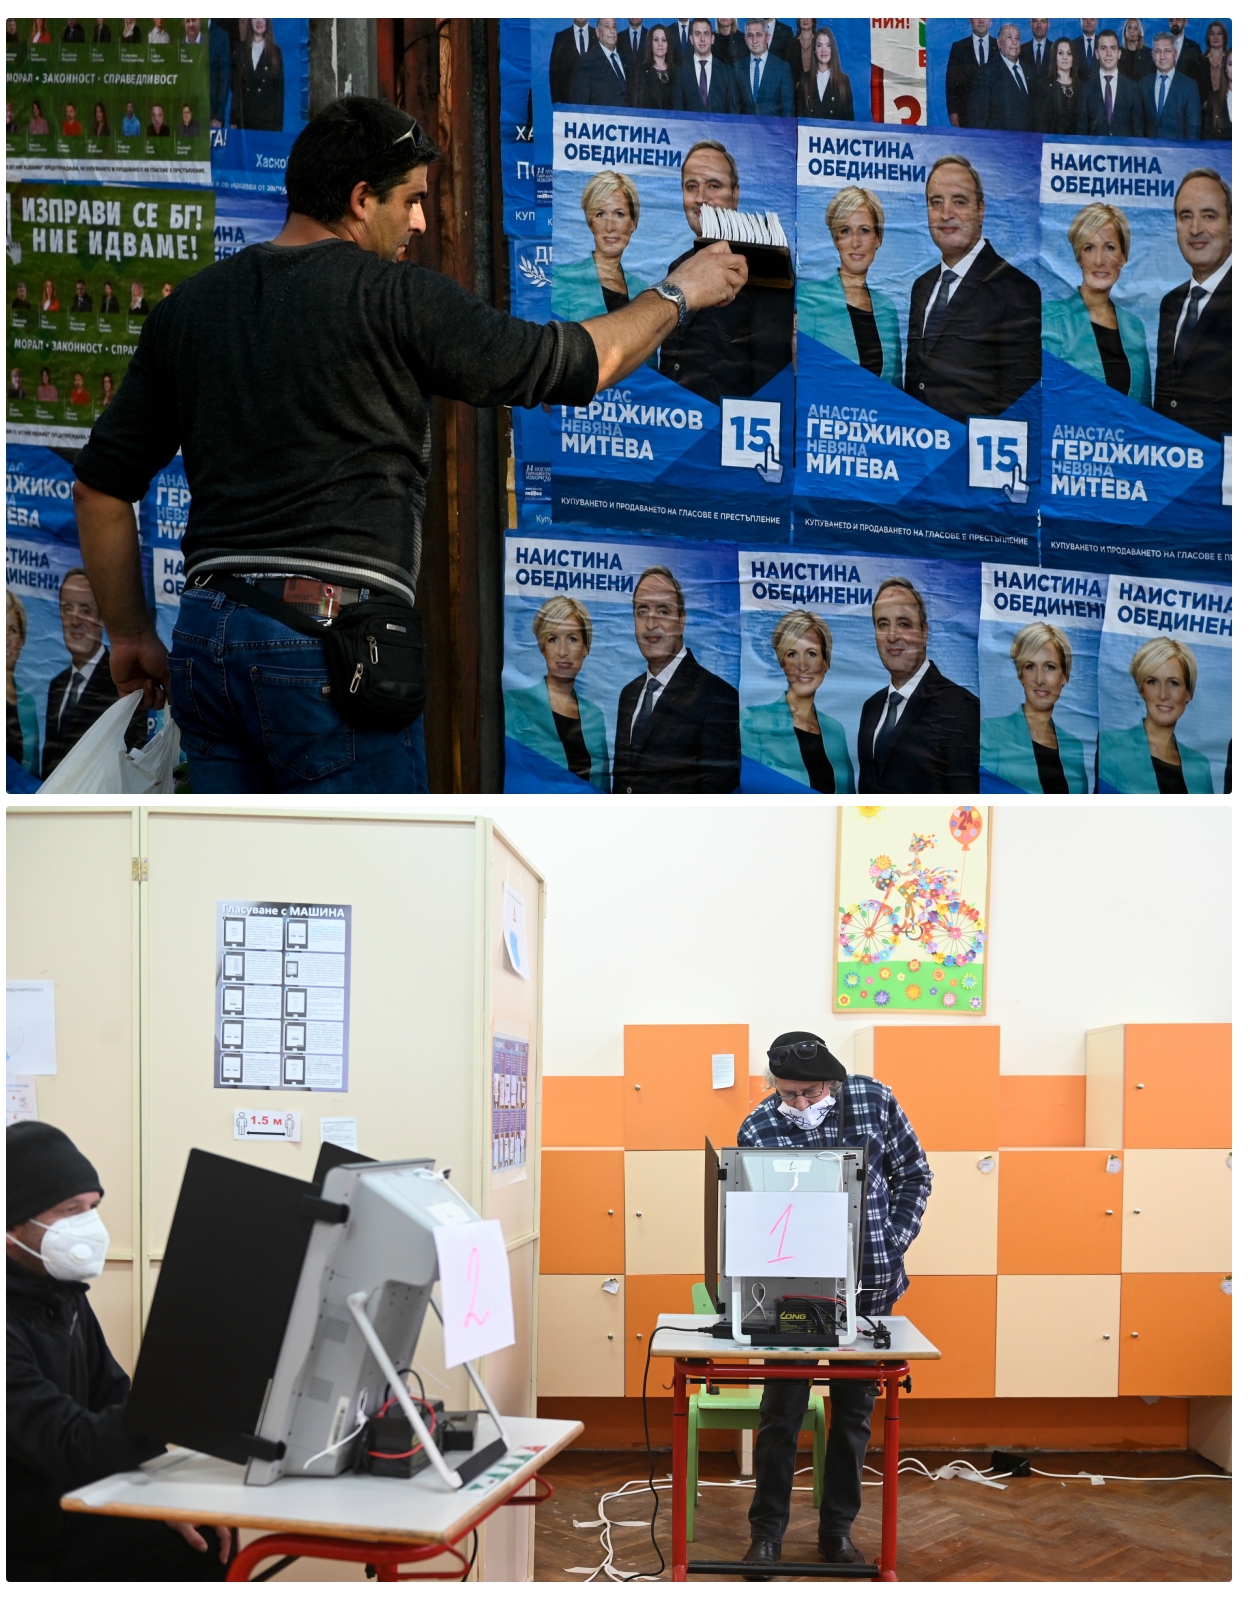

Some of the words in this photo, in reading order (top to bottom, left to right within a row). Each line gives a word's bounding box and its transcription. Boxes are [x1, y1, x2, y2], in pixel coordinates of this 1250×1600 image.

[6, 73, 33, 83] МОРАЛ
[42, 73, 95, 84] ЗАКОННОСТ
[103, 73, 178, 85] СПРАВЕДЛИВОСТ
[564, 121, 671, 146] НАИСТИНА
[564, 142, 682, 168] ОБЕДИНЕНИ
[808, 135, 914, 160] НАИСТИНА
[517, 161, 535, 180] П
[808, 158, 926, 183] ОБЕДИНЕНИ
[1051, 152, 1162, 175] НАИСТИНА
[1050, 175, 1175, 198] ОБЕДИНЕНИ
[22, 197, 120, 226] ИЗПРАВИ
[133, 202, 158, 228] СЕ
[170, 204, 202, 231] БГ!
[516, 211, 536, 221] КУП
[32, 227, 78, 254] НИЕ
[89, 230, 198, 261] ИДВАМЕ!
[14, 338, 43, 350] МОРАЛ
[52, 340, 103, 354] ЗАКОННОСТ
[561, 401, 703, 430] ГЕРДЖИКОВ
[807, 403, 878, 423] АНАСТАС
[561, 418, 623, 437] НЕВЯНА
[730, 415, 772, 453] 15
[806, 418, 950, 451] ГЕРДЖИКОВ
[1053, 424, 1125, 443] АНАСТАС
[561, 433, 654, 461] МИТЕВА
[806, 438, 868, 457] НЕВЯНА
[977, 435, 1019, 472] 15
[1051, 439, 1204, 470] ГЕРДЖИКОВ
[806, 453, 900, 482] МИТЕВА
[1051, 460, 1114, 478] НЕВЯНА
[6, 474, 74, 500] ДЖИКО
[156, 487, 192, 508] ГЕР
[1051, 474, 1148, 503] МИТЕВА
[561, 497, 608, 508] КУПУВАНЕТО
[616, 502, 666, 514] ПРОДАВАНЕТО
[667, 507, 677, 516] НА
[678, 509, 712, 519] ГЛАСОВЕ
[714, 512, 718, 520] Е
[720, 512, 780, 525] ПРЕСТЪПЛЕНИЕ
[805, 518, 852, 529] КУПУВАНЕТО
[859, 523, 911, 536] ПРОДАВАНЕТО
[913, 529, 924, 537] НА
[925, 530, 960, 540] ГЛАСОВЕ
[962, 533, 967, 541] Е
[969, 533, 1028, 545] ПРЕСТЪПЛЕНИЕ
[516, 546, 623, 571] НАИСТИНА
[1050, 541, 1099, 553] КУПУВАНЕТО
[1107, 546, 1162, 558] ПРОДАВАНЕТО
[1163, 550, 1175, 559] НА
[1177, 551, 1215, 561] ГЛАСОВЕ
[1217, 553, 1222, 561] Е
[515, 568, 634, 594] ОБЕДИНЕНИ
[751, 561, 861, 584] НАИСТИНА
[994, 570, 1102, 598] НАИСТИНА
[751, 582, 873, 607] ОБЕДИНЕНИ
[1119, 582, 1232, 614] НАИСТИНА
[222, 903, 278, 917] Гласуване
[281, 908, 287, 916] с
[290, 906, 345, 918] МАШИНА
[250, 1115, 269, 1126] 1.5
[273, 1117, 282, 1126] м
[767, 1203, 795, 1264] 1
[464, 1247, 490, 1329] 2
[780, 1311, 807, 1320] LONG
